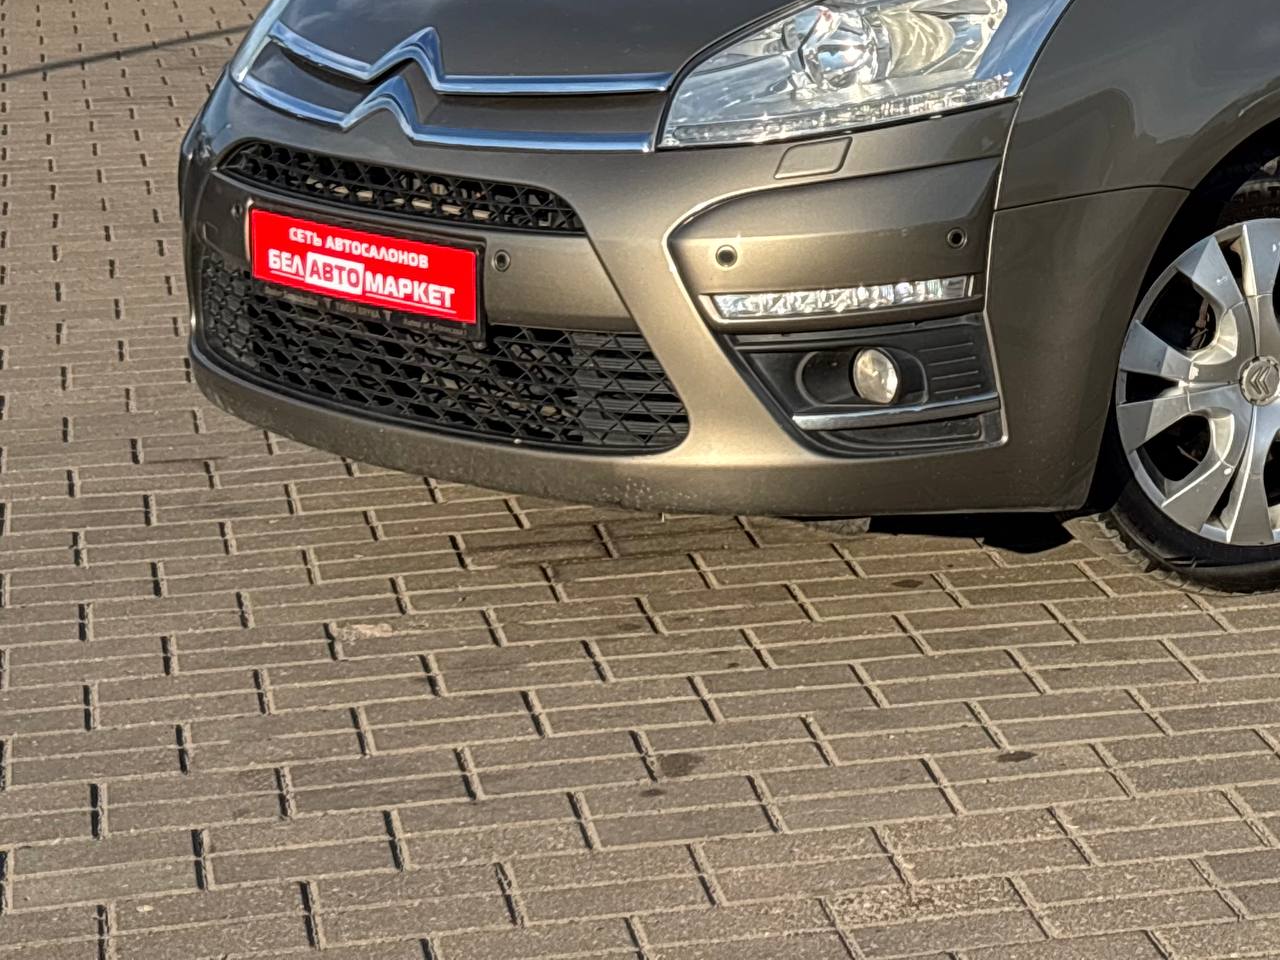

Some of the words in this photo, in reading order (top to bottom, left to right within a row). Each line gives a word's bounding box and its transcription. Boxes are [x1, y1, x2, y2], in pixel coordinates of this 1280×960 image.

[288, 227, 323, 247] СЕТЬ
[325, 235, 430, 269] АВТОСАЛОНОВ
[268, 248, 455, 308] БЕЛАВТОМАРКЕТ
